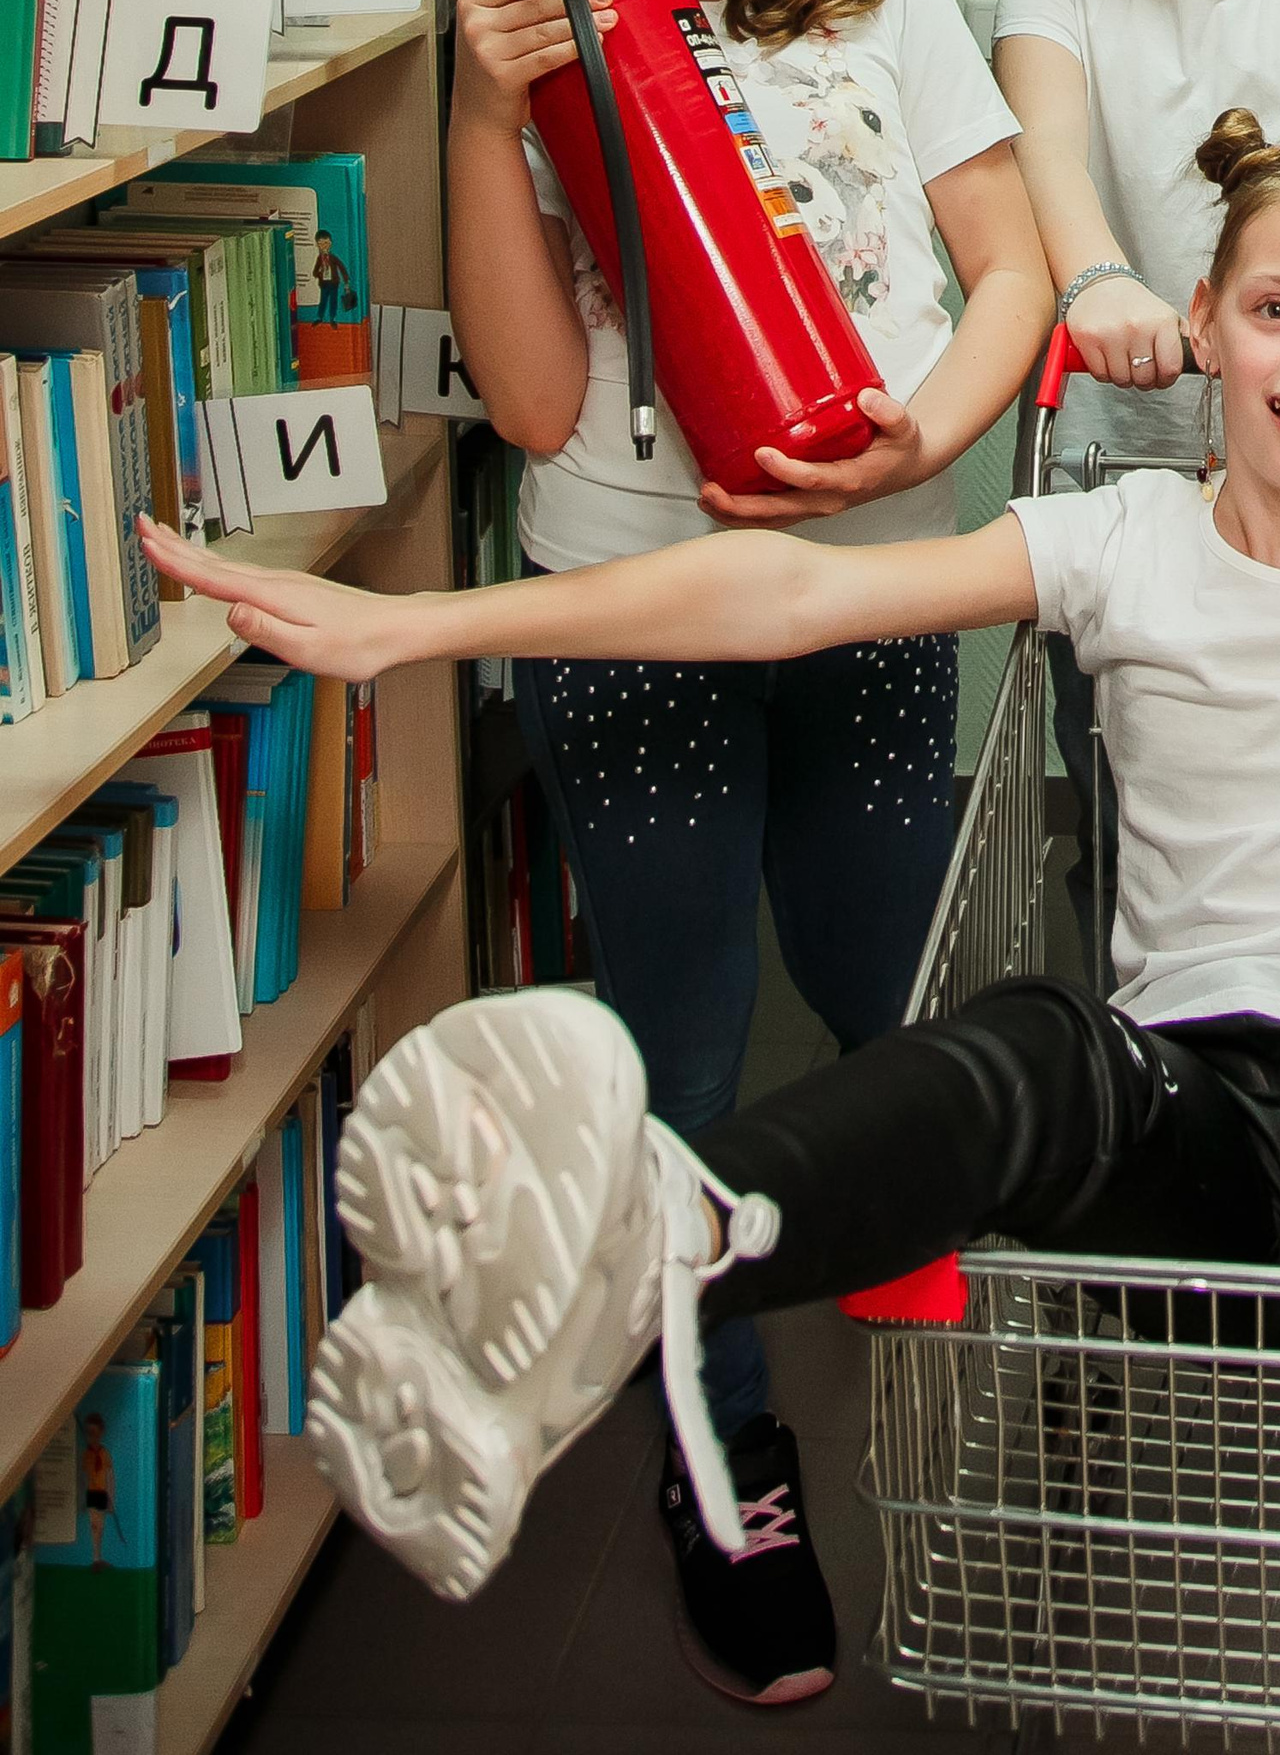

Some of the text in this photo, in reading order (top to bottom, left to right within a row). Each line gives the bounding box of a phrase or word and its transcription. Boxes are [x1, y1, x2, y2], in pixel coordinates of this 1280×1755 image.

[138, 16, 219, 111] Д
[14, 438, 27, 517] ИЗБРАННОЕ
[275, 413, 341, 482] И
[22, 543, 37, 618] ЖИТКОВ
